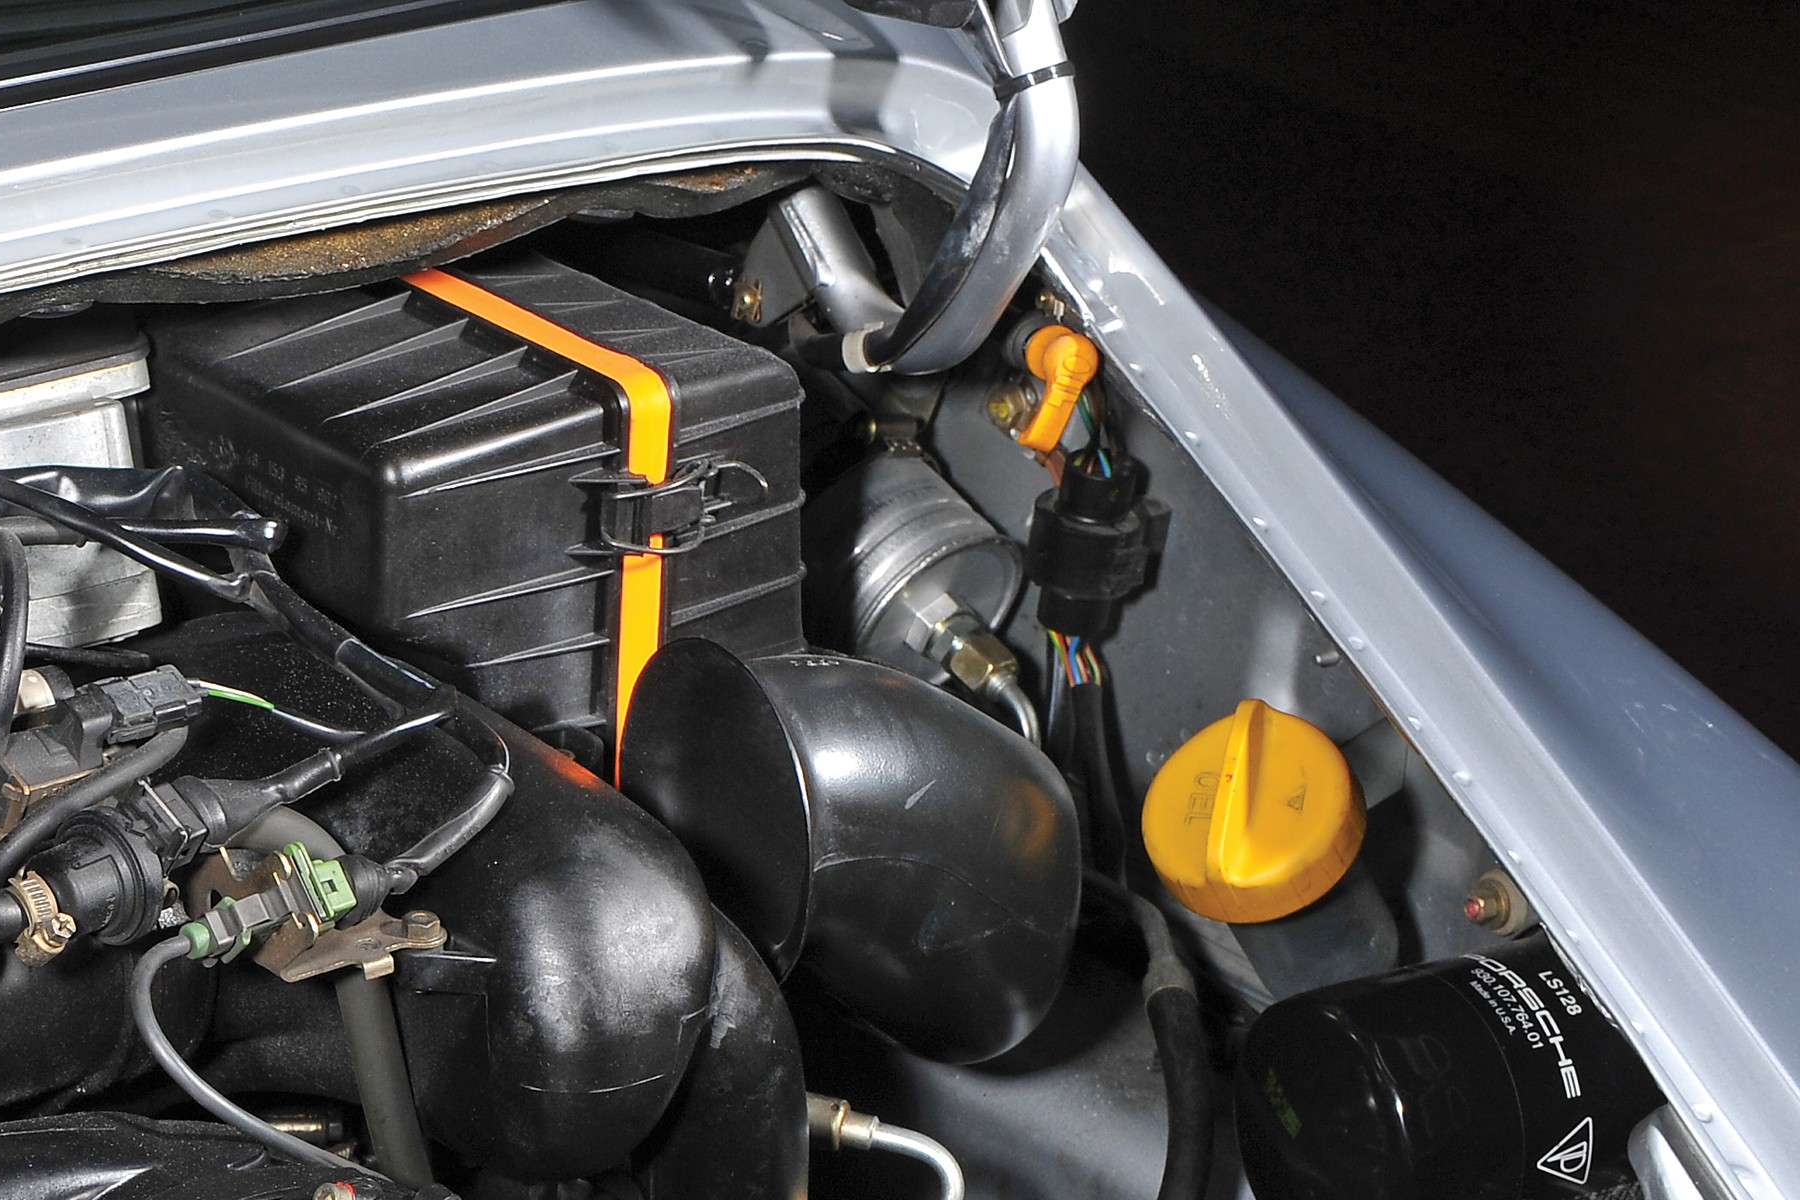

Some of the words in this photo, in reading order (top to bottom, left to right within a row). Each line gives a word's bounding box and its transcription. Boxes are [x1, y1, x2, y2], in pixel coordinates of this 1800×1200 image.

[1459, 953, 1581, 1099] PORSCHE
[1470, 967, 1545, 1050] 930.107.764.01
[1538, 970, 1582, 1016] LS128
